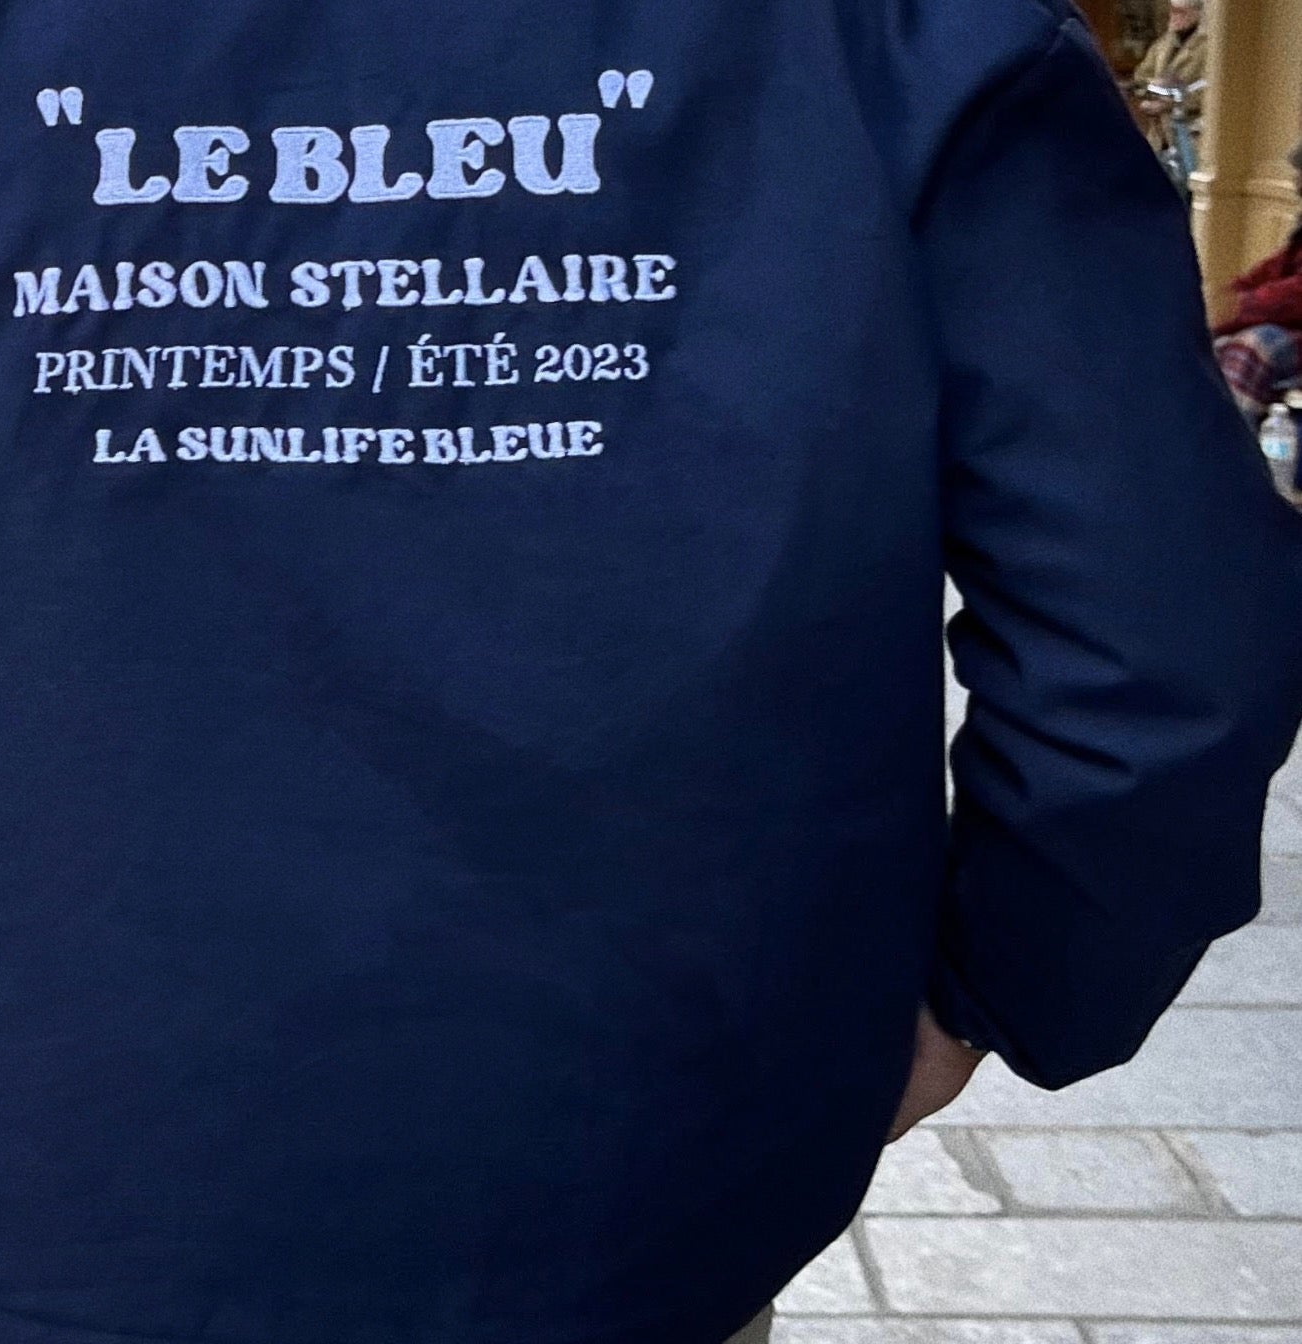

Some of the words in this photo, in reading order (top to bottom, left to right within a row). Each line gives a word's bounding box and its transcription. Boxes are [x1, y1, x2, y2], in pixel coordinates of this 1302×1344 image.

[13, 260, 269, 317] MAISON
[290, 253, 677, 309] STELLAIRE
[33, 344, 356, 394] PRINTEMPS
[372, 345, 389, 394] /
[407, 333, 520, 388] ÉTÉ
[533, 343, 650, 383] 2023
[92, 427, 167, 464] LA
[176, 425, 415, 465] SUNLIFE
[421, 420, 604, 465] BLEUE
